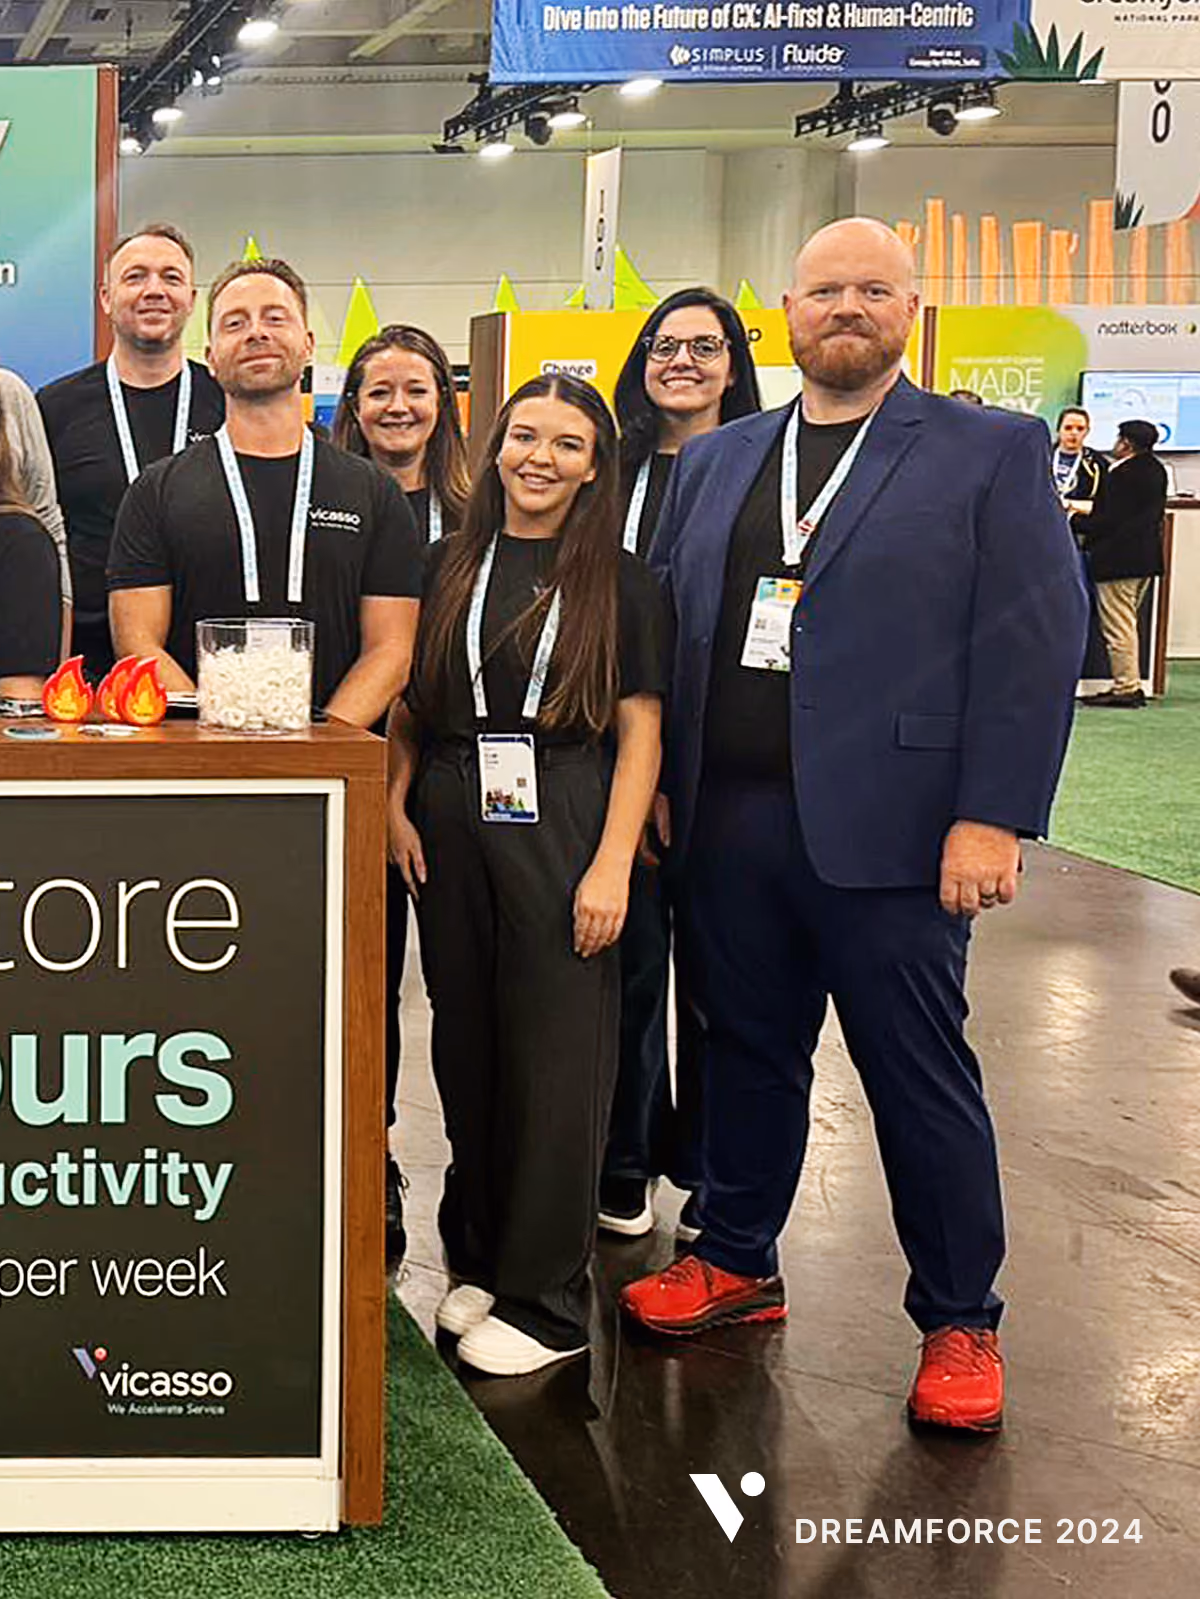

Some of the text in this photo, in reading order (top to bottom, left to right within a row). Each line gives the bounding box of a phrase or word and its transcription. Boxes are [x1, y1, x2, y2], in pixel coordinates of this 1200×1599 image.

[543, 2, 974, 31] Dive into the Future of CX: AI-first & Human-Centric
[691, 48, 765, 62] SIMPLUS
[949, 367, 1043, 397] MADE
[309, 508, 361, 526] vicasso
[91, 1246, 228, 1298] week
[100, 1362, 233, 1398] vicasso
[107, 1401, 226, 1415] We Accelerate Service
